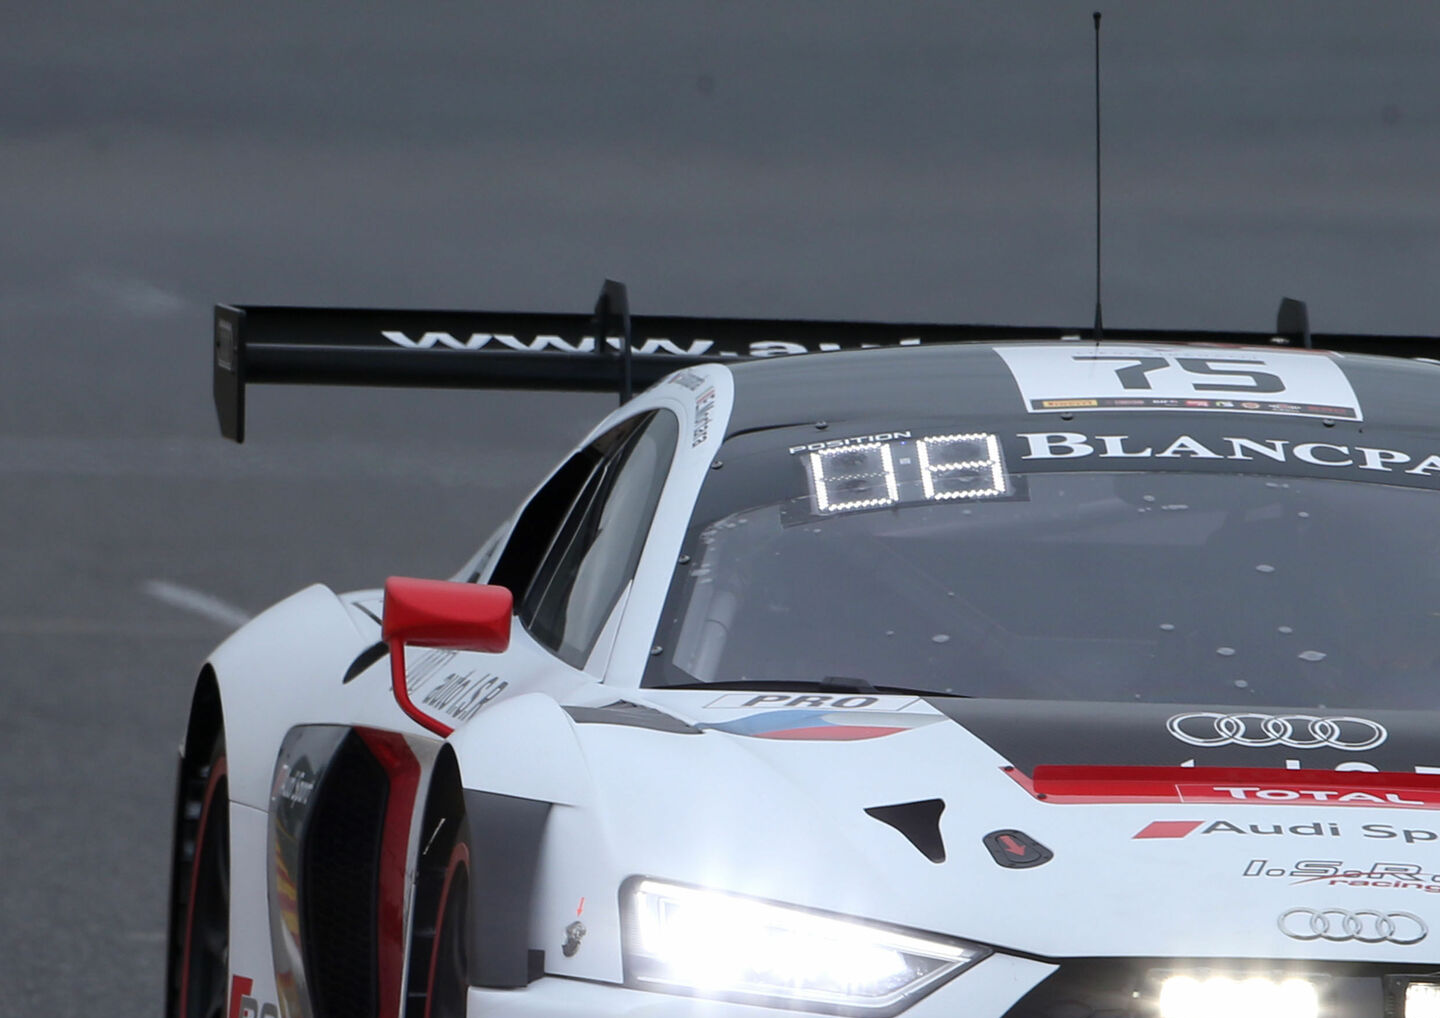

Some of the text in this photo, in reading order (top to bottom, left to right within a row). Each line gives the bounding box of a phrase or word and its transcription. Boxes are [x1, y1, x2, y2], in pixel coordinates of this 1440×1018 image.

[1072, 355, 1287, 394] 75
[789, 431, 912, 455] POSITION
[743, 694, 879, 709] PRO
[1213, 786, 1425, 806] TOTAL
[1201, 820, 1341, 838] Audi
